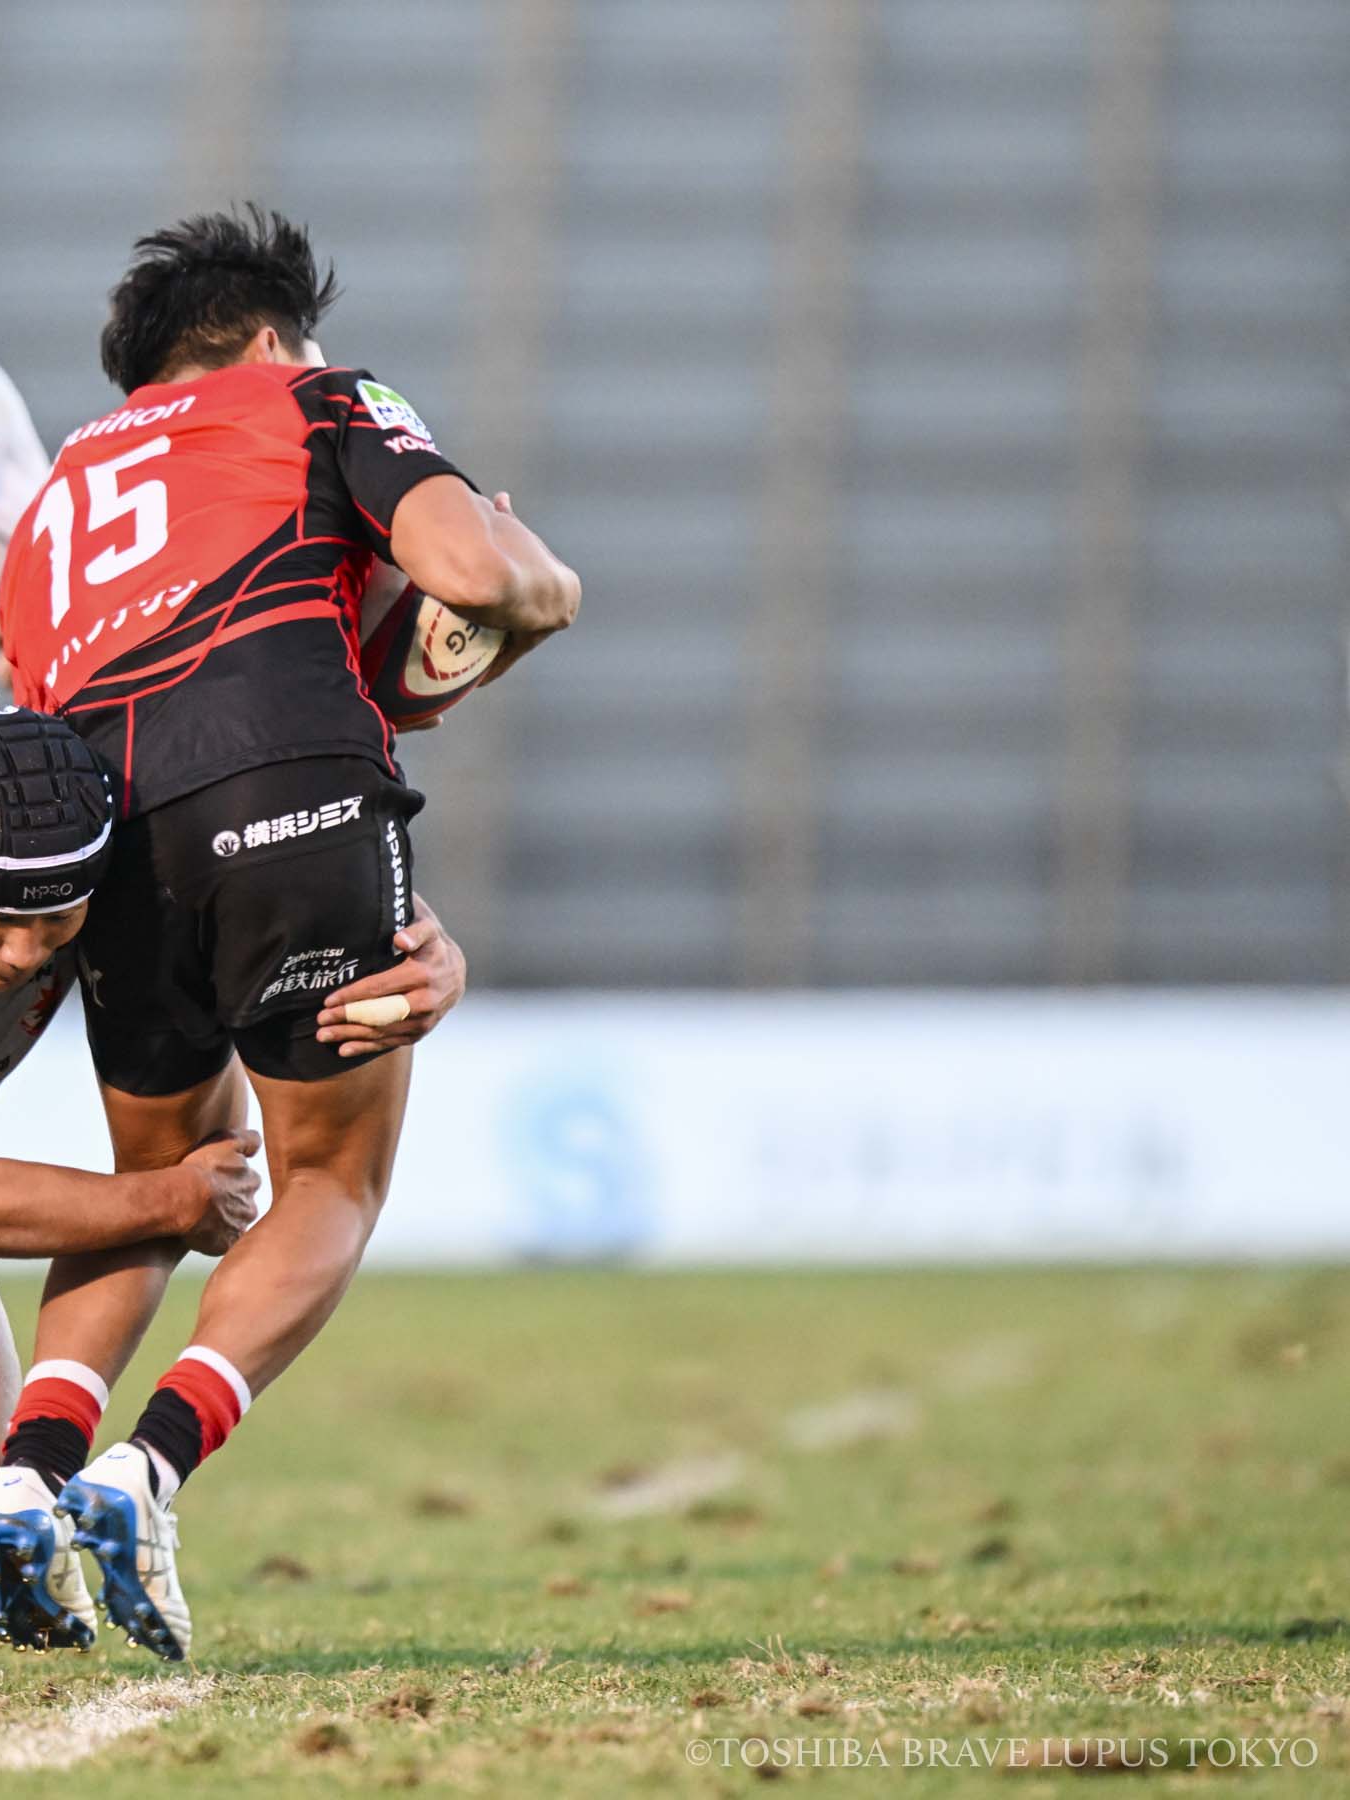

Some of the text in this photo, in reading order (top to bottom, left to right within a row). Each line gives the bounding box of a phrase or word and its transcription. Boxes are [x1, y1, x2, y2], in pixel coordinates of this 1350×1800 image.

[32, 436, 171, 630] 15
[243, 795, 364, 849] 横浜シミズ
[259, 957, 360, 1004] 西鉄旅行
